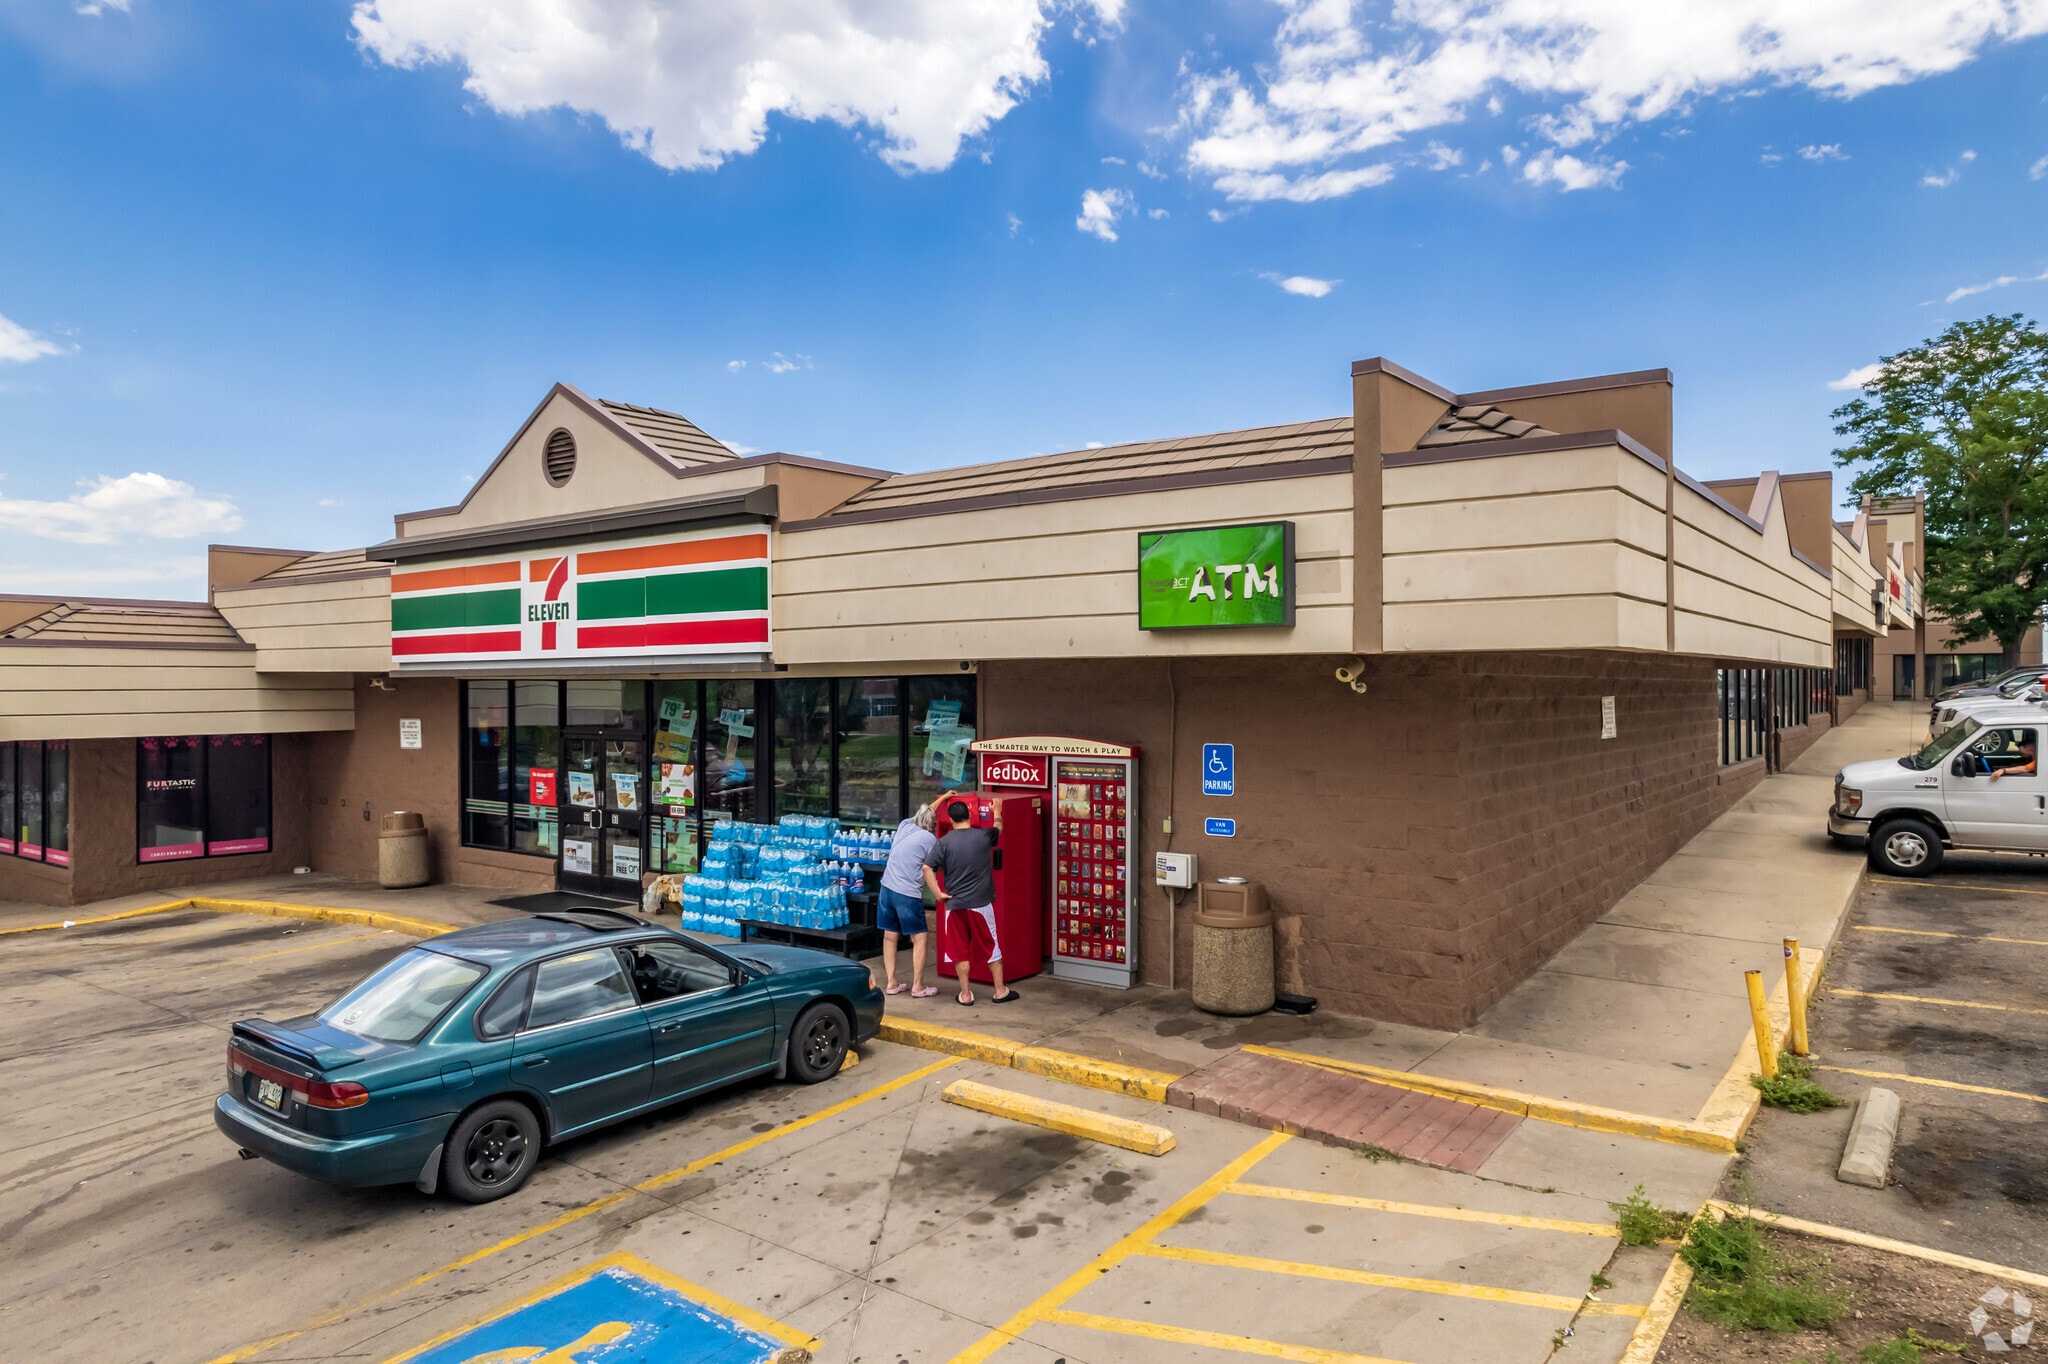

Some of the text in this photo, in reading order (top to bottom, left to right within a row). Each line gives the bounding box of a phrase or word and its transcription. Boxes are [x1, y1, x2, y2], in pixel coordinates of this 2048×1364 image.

[1189, 563, 1279, 602] ATM
[995, 744, 1029, 752] SMARTER
[1064, 746, 1091, 754] WATCH
[986, 764, 1040, 783] redbox
[146, 779, 196, 788] FURTASTIC
[1204, 780, 1232, 791] PARKING
[616, 866, 628, 875] FREE
